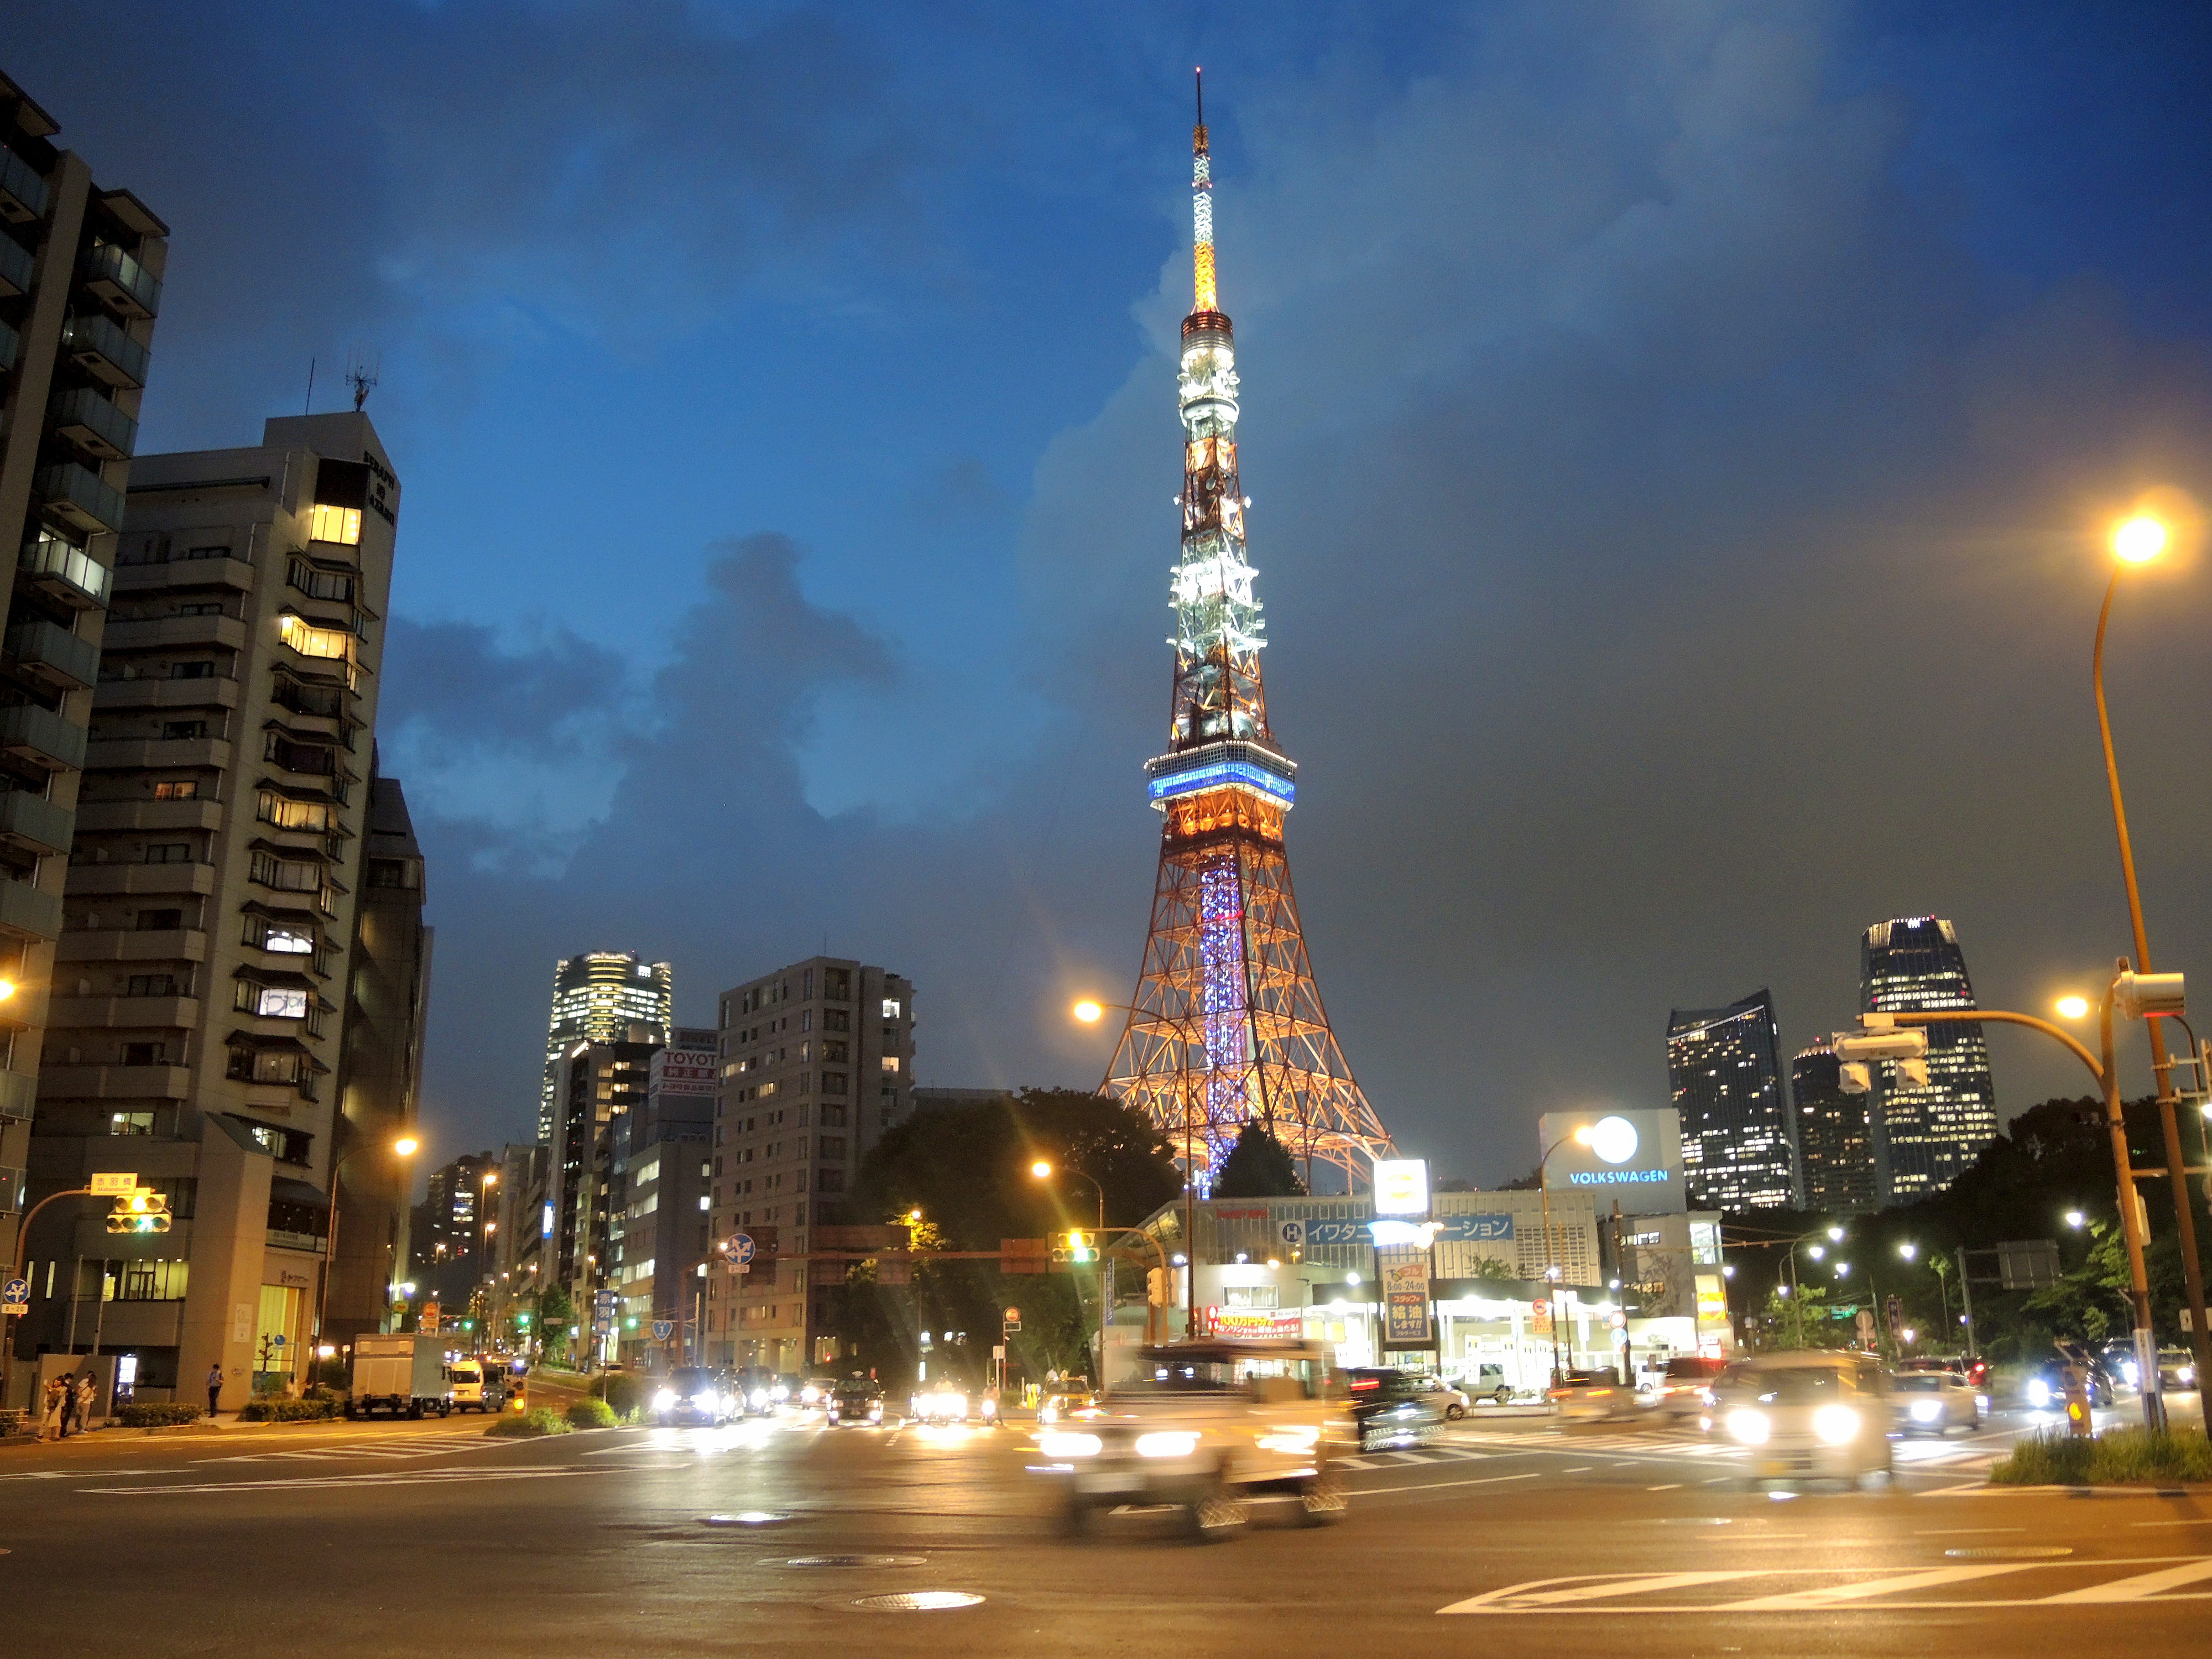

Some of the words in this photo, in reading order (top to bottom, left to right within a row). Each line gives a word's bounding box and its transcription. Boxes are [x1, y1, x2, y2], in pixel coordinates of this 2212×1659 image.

[664, 1052, 717, 1066] TOYOT
[96, 1177, 131, 1186] 赤羽橋
[1569, 1170, 1668, 1185] VOLKSWAGEN
[597, 1293, 611, 1332] 赤羽橋
[1392, 1305, 1422, 1319] 給油
[1219, 1315, 1275, 1327] 100万円分の
